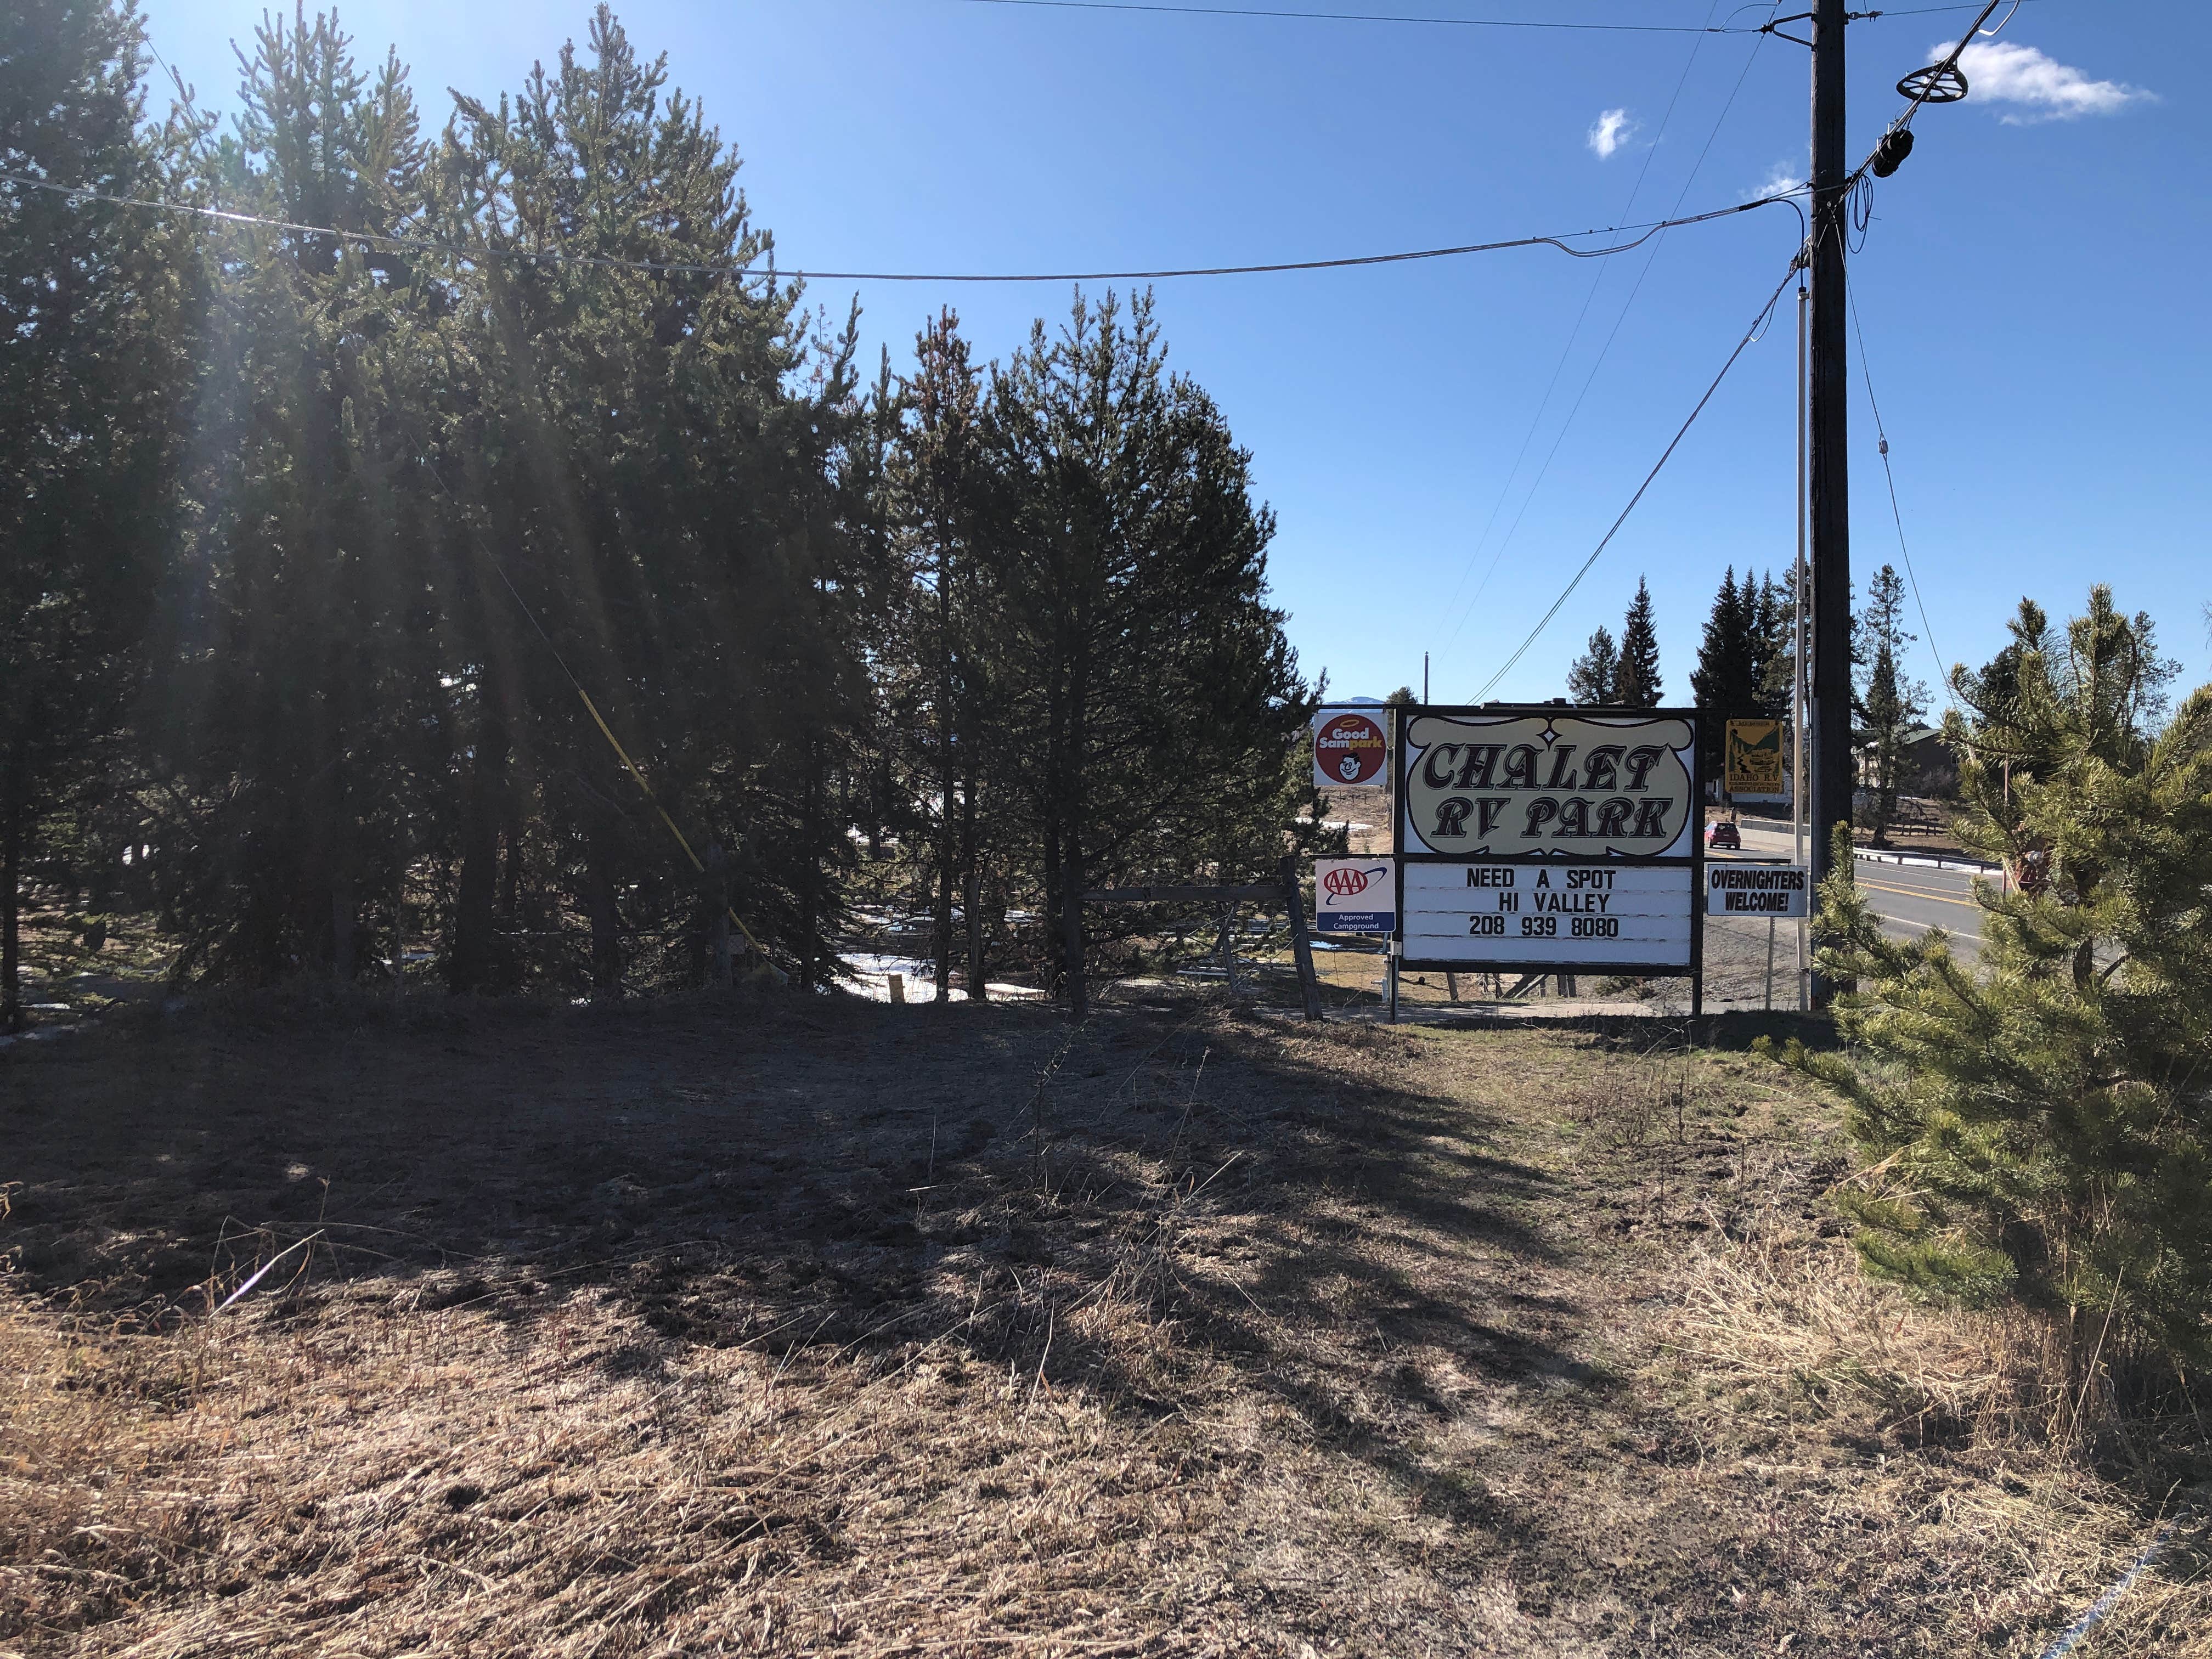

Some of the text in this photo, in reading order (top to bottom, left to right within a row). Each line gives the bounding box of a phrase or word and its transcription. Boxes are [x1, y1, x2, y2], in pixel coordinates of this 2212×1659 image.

[1332, 727, 1369, 740] Good
[1423, 742, 1669, 792] CHALET
[1430, 797, 1674, 839] RV PARK
[1329, 868, 1363, 895] AAA
[1467, 868, 1616, 889] NEED A SPOT
[1711, 869, 1804, 890] OVERNIGHTERS
[1499, 892, 1610, 913] HI VALLEY
[1725, 891, 1790, 912] WELCOME!
[1339, 913, 1374, 922] Approved
[1470, 915, 1619, 938] 208 939 8080
